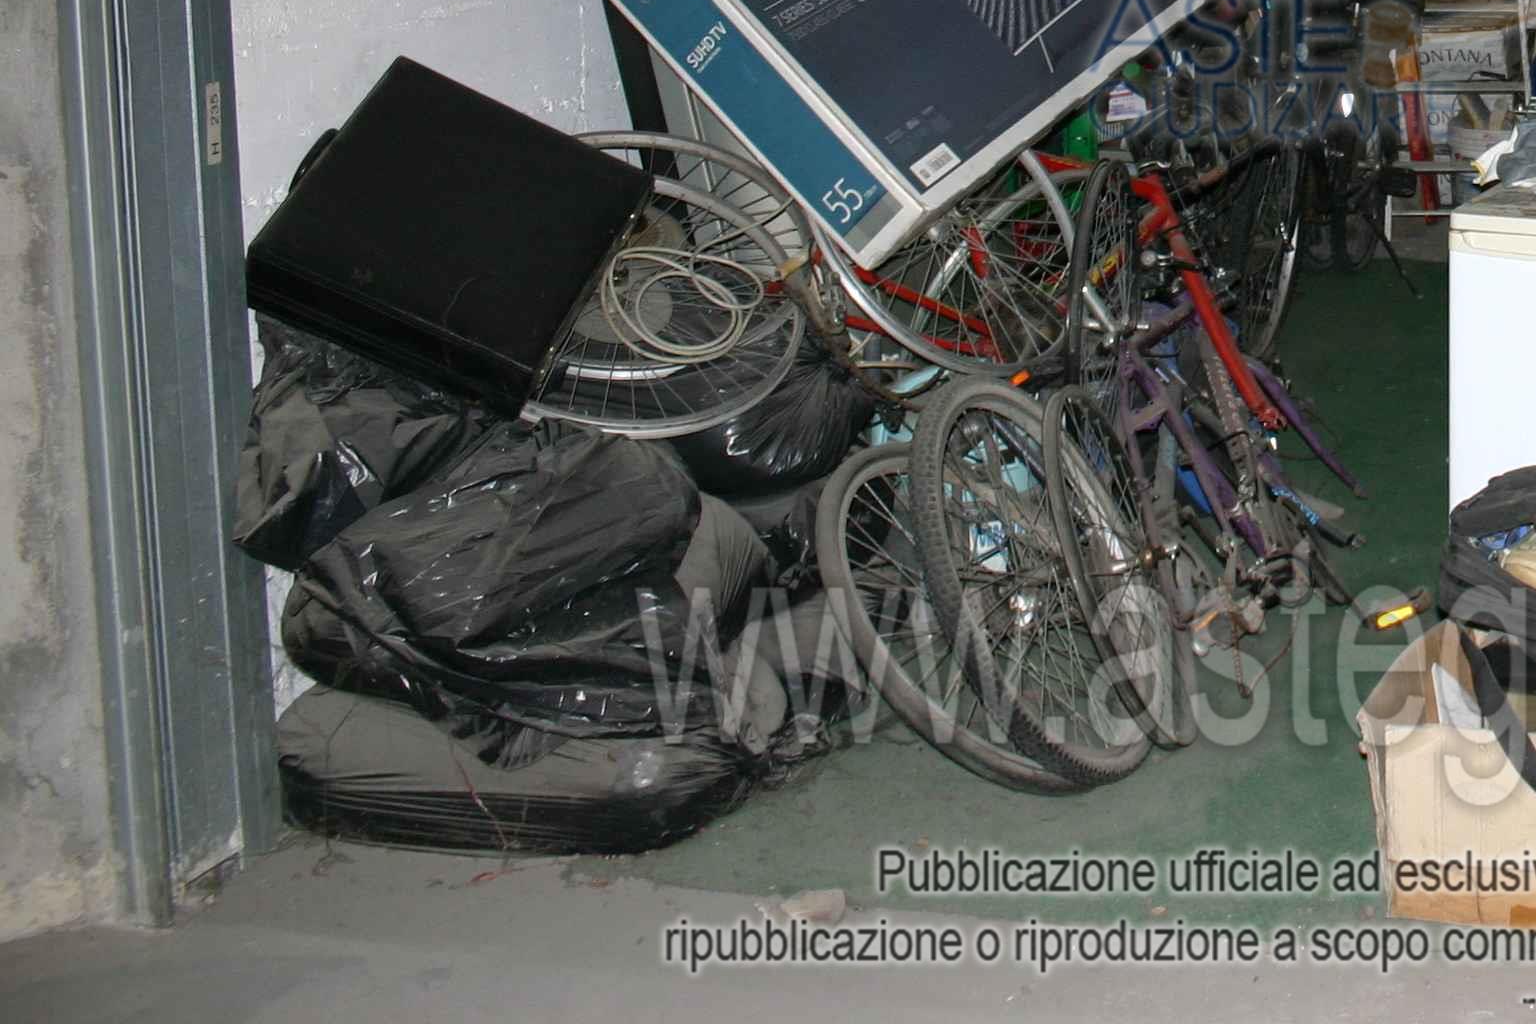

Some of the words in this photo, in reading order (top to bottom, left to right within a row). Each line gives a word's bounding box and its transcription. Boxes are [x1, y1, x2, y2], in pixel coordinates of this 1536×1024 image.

[1420, 48, 1493, 67] ONTANA
[211, 142, 220, 155] H
[821, 177, 864, 224] 55
